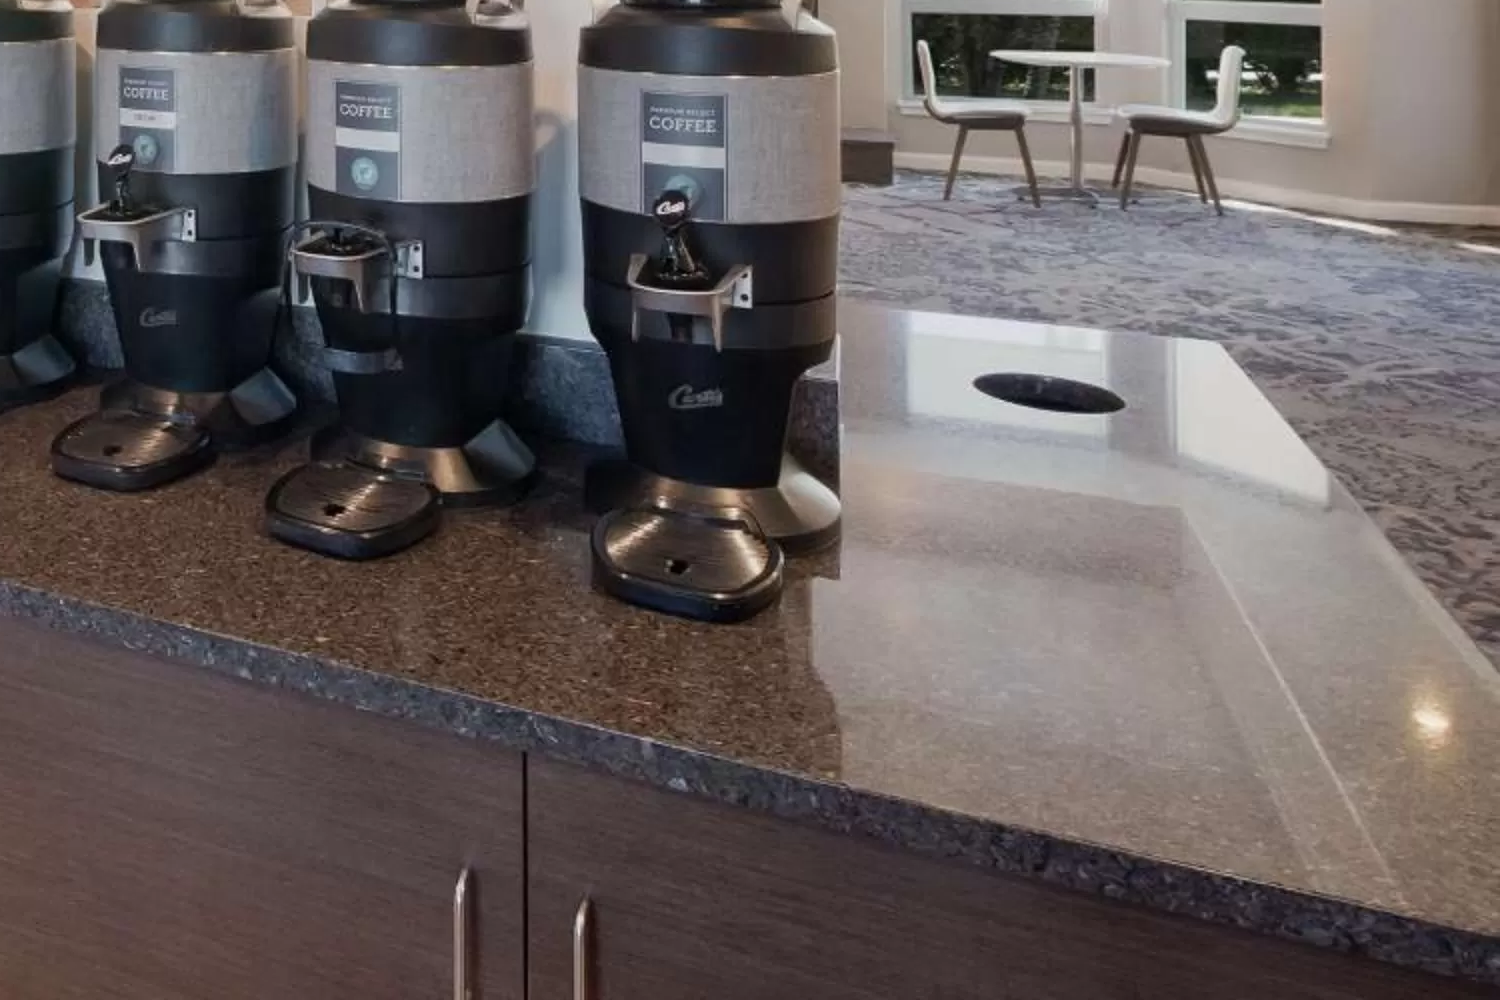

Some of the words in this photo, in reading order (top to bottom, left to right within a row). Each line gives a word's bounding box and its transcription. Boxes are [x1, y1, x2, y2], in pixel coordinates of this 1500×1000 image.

[123, 86, 169, 101] COFFEE
[340, 103, 392, 119] COFFEE
[649, 115, 717, 133] COFFEE
